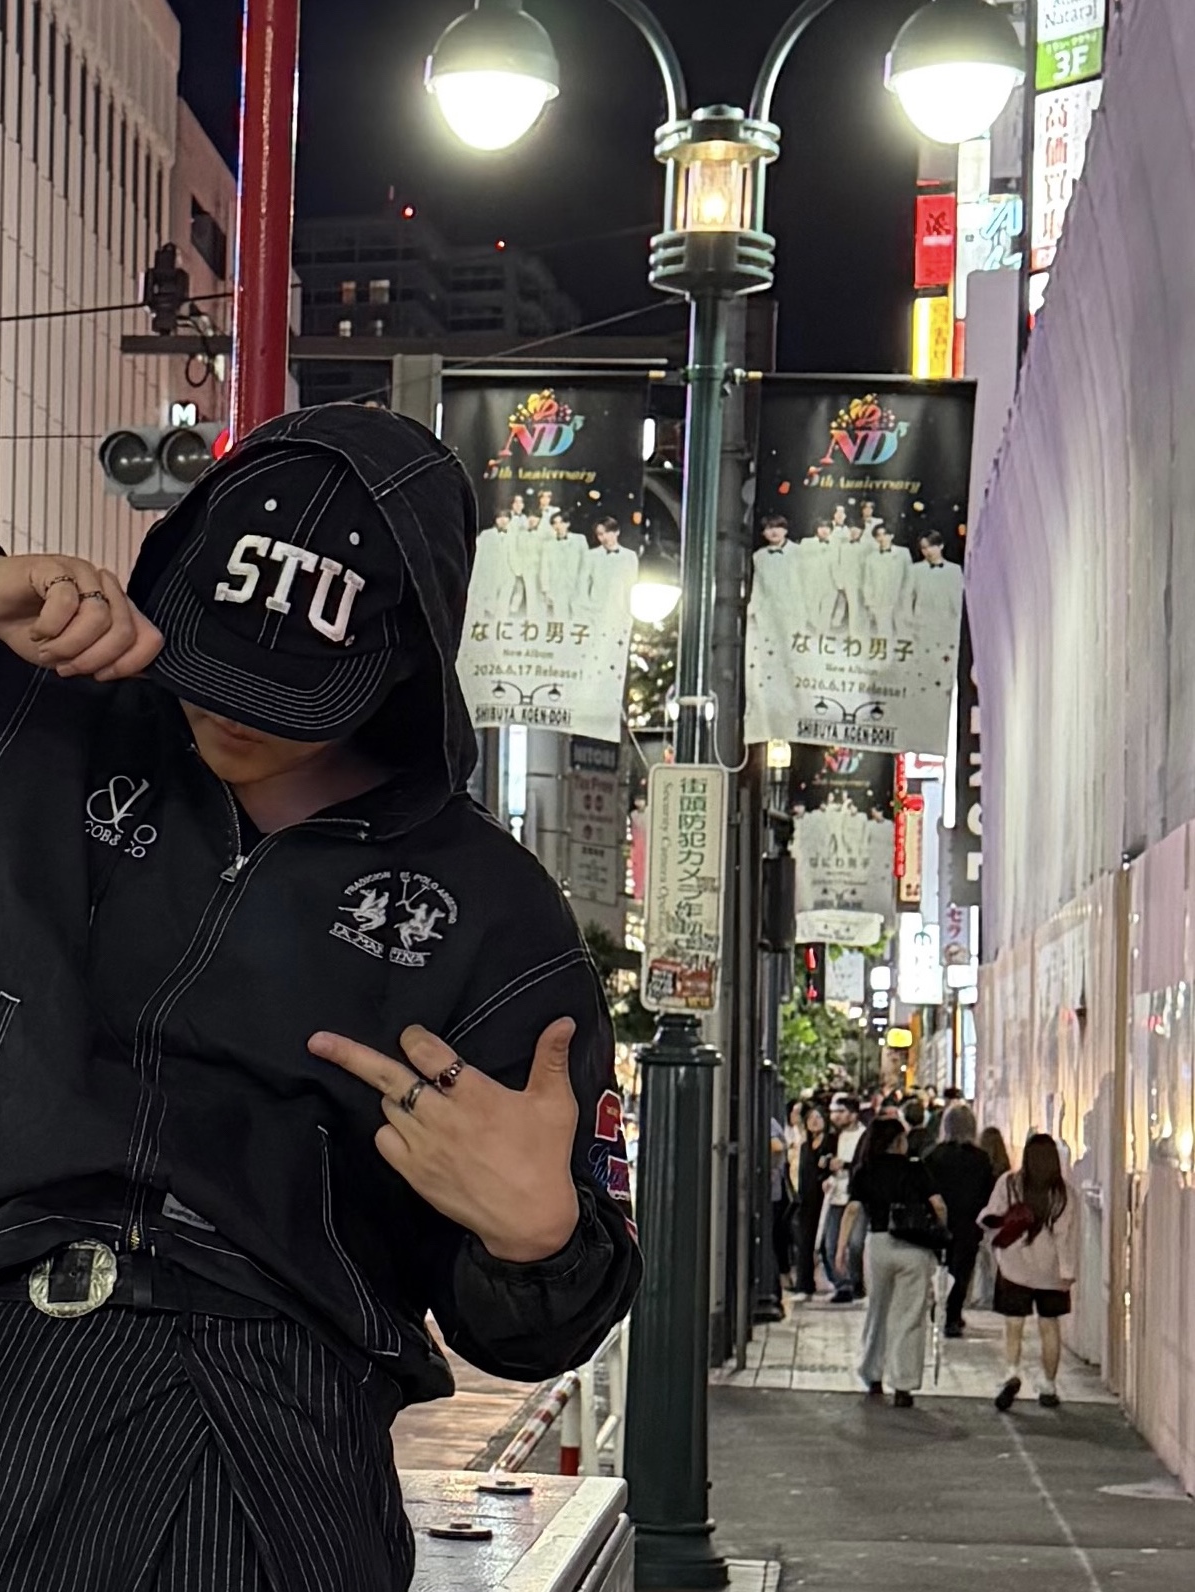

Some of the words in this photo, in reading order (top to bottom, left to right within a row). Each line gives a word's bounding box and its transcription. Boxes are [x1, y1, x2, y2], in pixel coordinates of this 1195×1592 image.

[1052, 43, 1090, 80] 3F
[471, 620, 590, 645] なにわ男子
[791, 632, 914, 662] なにわ男子
[475, 706, 515, 724] SHIBUYA
[797, 719, 838, 738] SHIBUYA
